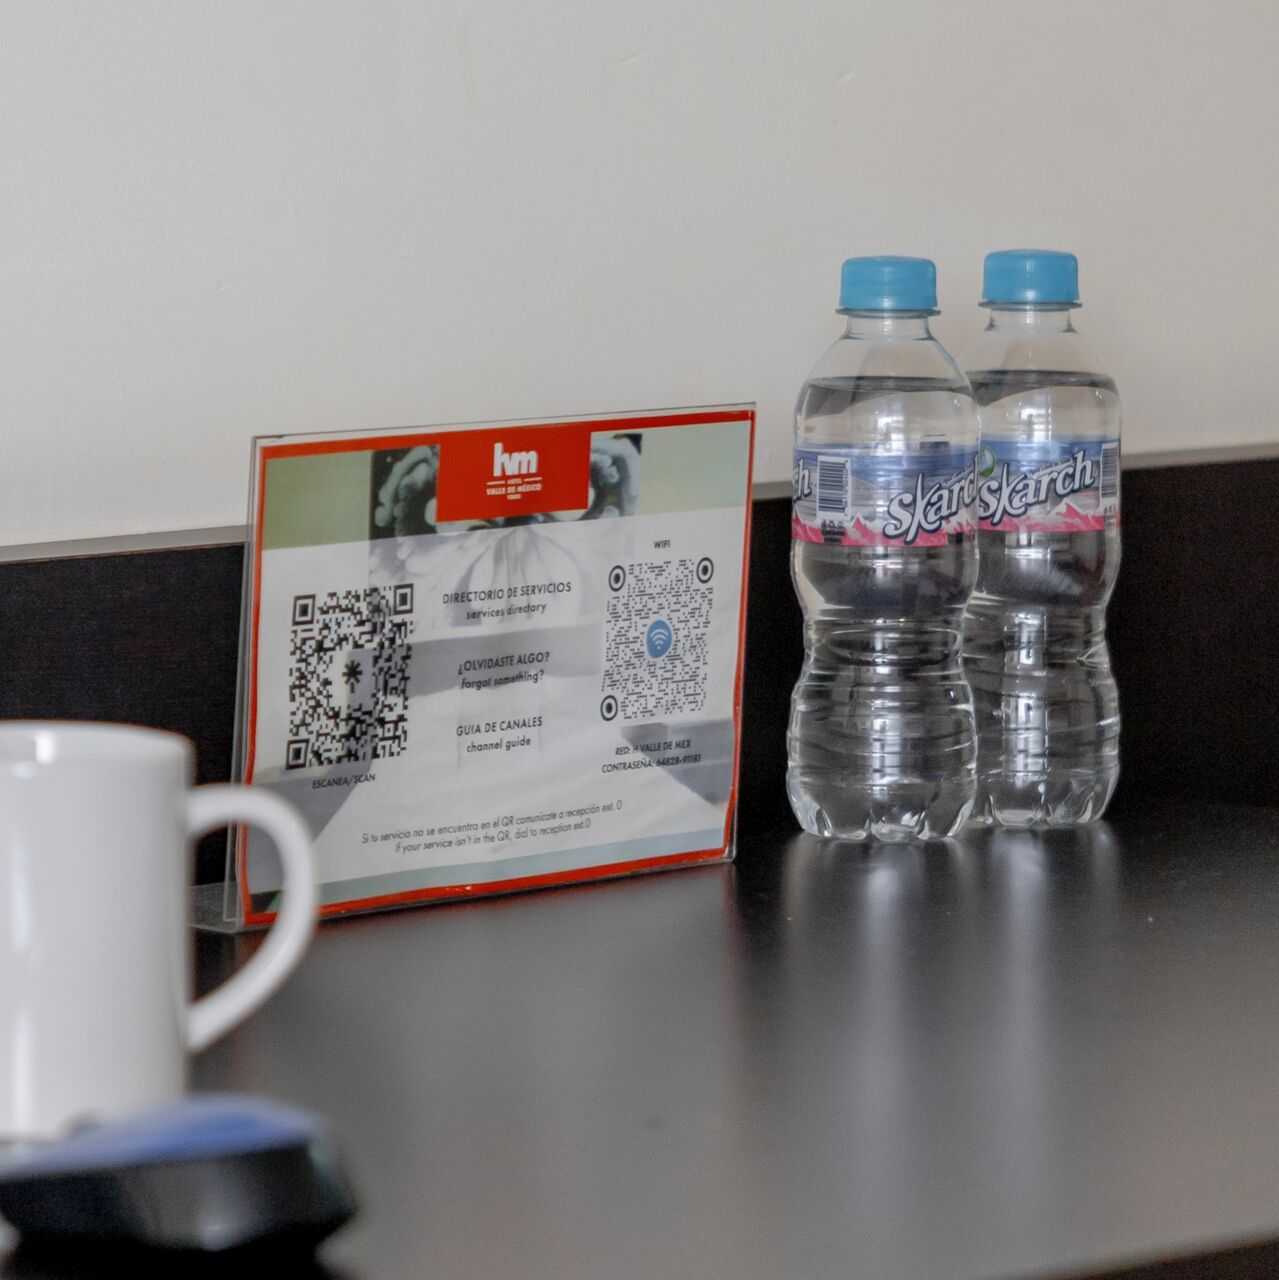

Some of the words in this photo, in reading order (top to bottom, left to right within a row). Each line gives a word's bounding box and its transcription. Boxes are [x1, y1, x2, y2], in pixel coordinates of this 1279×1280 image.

[978, 448, 1096, 526] Skarch
[442, 589, 504, 604] DIRECTORIO
[506, 587, 518, 599] DE
[520, 582, 572, 596] SERVICIOS
[466, 607, 505, 620] services
[506, 603, 547, 616] directory
[457, 655, 514, 675] ¿OLVIDASTE
[516, 651, 550, 665] ALGO?
[461, 677, 491, 691] forgot
[494, 669, 545, 686] something?
[456, 724, 481, 737] GUIA
[484, 722, 497, 733] DE
[499, 716, 543, 731] CANALES
[466, 738, 503, 753] channel
[505, 735, 531, 751] guide
[640, 742, 661, 753] VALLE
[663, 741, 673, 751] DE
[674, 739, 691, 750] MEX
[601, 757, 654, 773] CONTRASEÑA:
[312, 773, 376, 790] ESCANEA/SCAN
[361, 832, 369, 844] Si
[371, 834, 378, 842] tu
[380, 829, 411, 841] servicio
[413, 829, 424, 837] no
[426, 828, 435, 836] se
[438, 823, 478, 835] encuentra
[481, 821, 491, 830] en
[493, 817, 499, 828] el
[501, 816, 514, 827] QR
[558, 811, 564, 819] a
[402, 842, 421, 855] your
[423, 839, 453, 850] service
[473, 835, 480, 844] in
[483, 832, 495, 843] the
[514, 828, 528, 840] dial
[530, 827, 537, 837] to
[540, 823, 572, 837] reception
